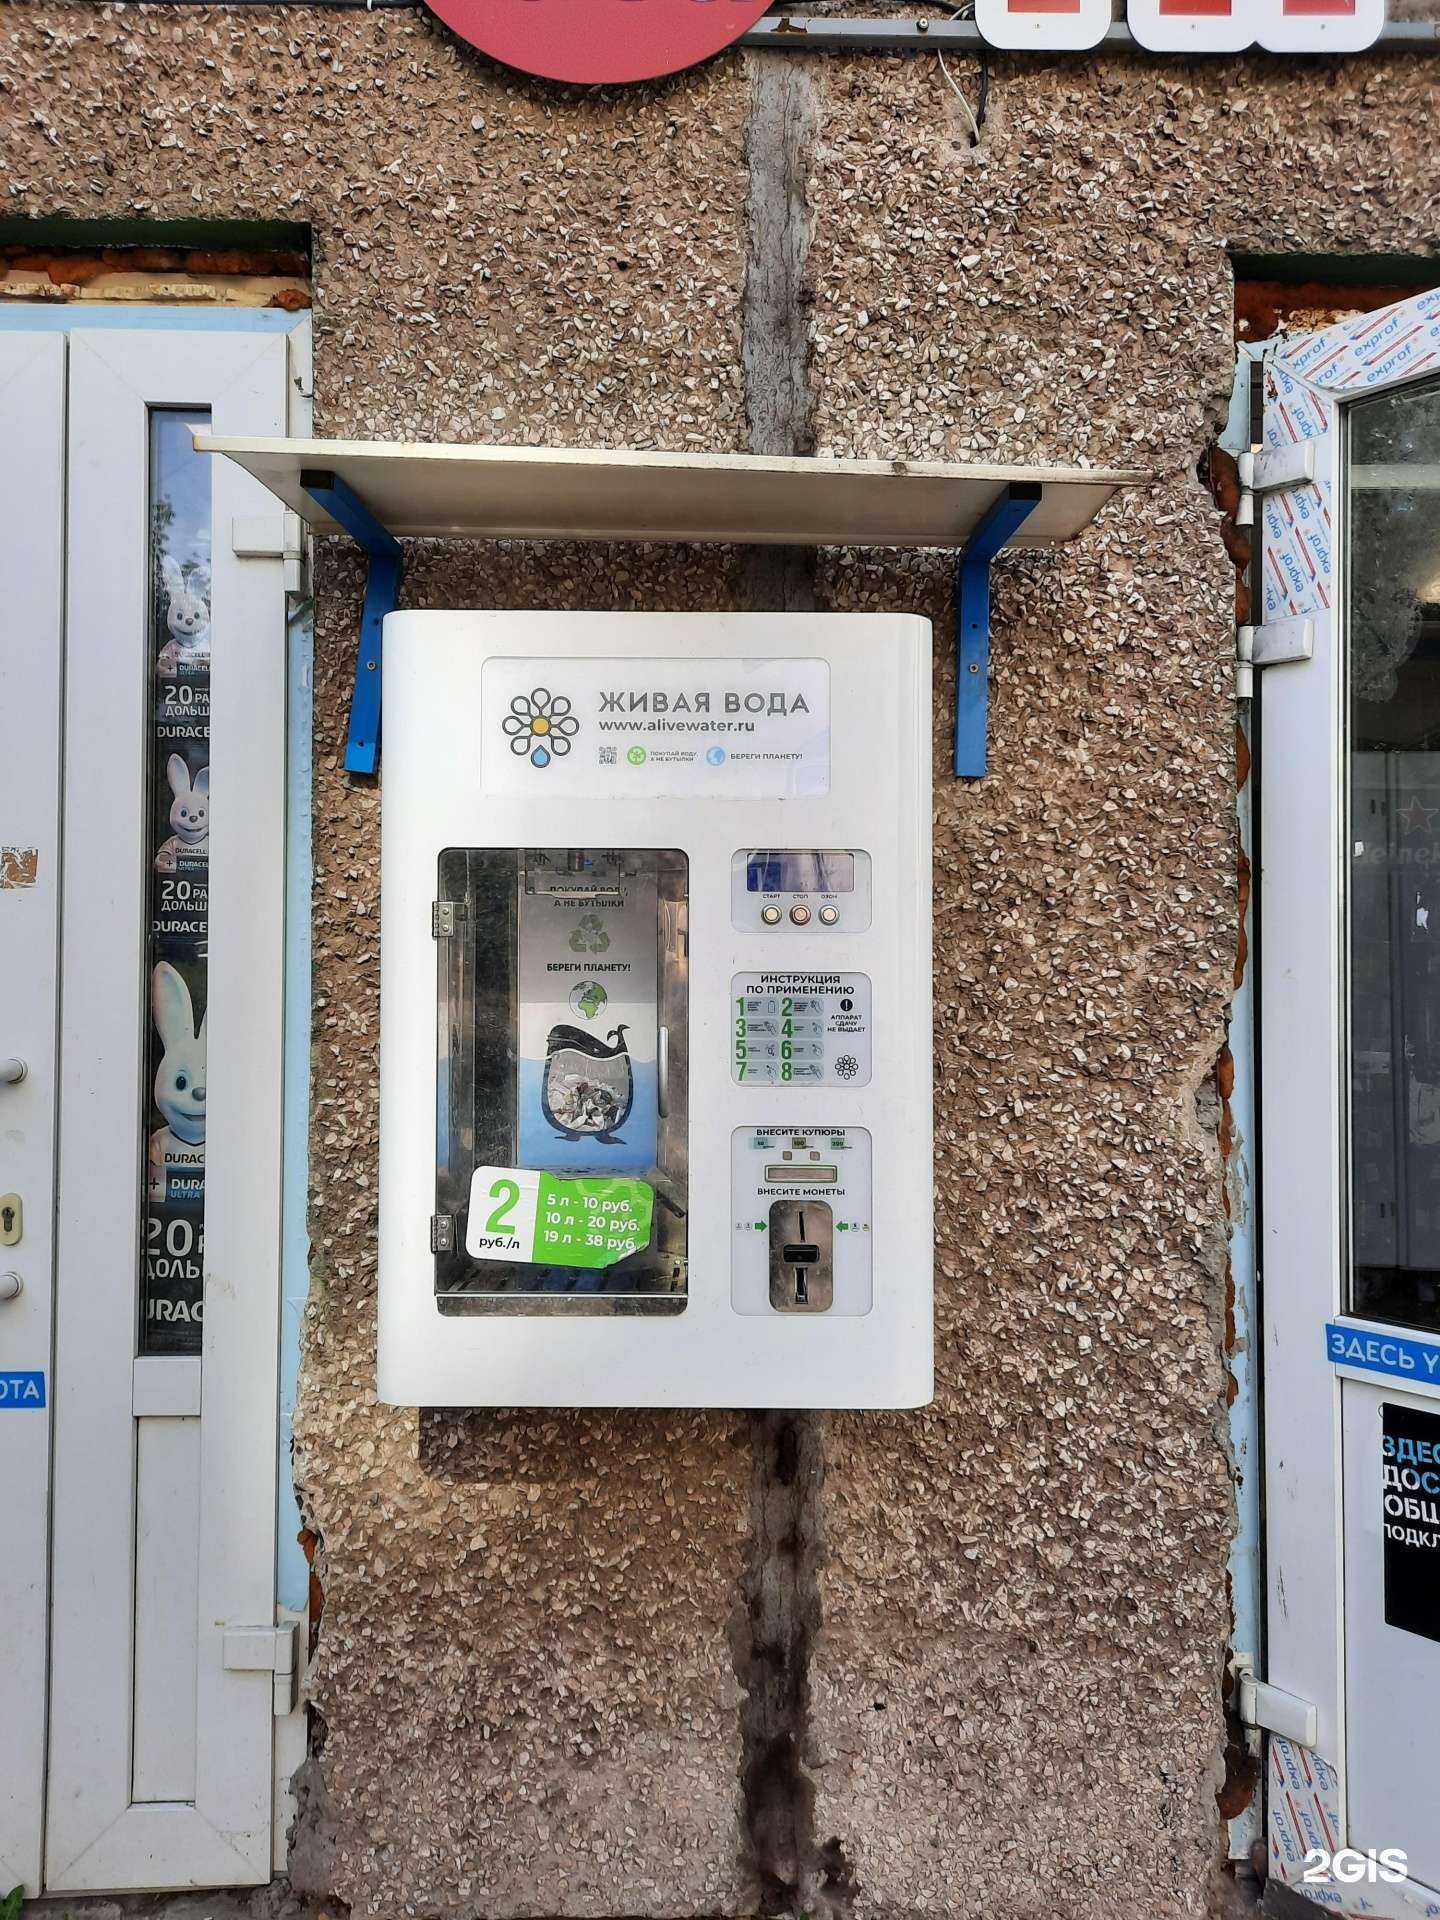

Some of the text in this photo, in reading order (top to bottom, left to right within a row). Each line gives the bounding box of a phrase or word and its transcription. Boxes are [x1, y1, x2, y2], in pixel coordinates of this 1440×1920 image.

[1354, 318, 1400, 357] exprof
[1367, 343, 1412, 383] exprof
[1278, 552, 1304, 593] exprof
[164, 685, 193, 705] 20
[598, 692, 811, 716] ЖИВАЯ ВОДА
[599, 717, 755, 733] www.alivewater.ru
[161, 880, 191, 900] 20
[547, 963, 631, 972] БЕРЕГИ ПЛАНЕТУ!
[746, 985, 855, 995] ПО ПРИМЕНЕНИЮ
[761, 975, 841, 985] ИНСТРУКЦИЯ
[736, 997, 745, 1016] 1
[781, 997, 793, 1017] 2
[736, 1018, 747, 1038] 3
[781, 1018, 793, 1038] 4
[736, 1040, 747, 1060] 5
[781, 1040, 792, 1060] 6
[736, 1061, 747, 1081] 7
[781, 1061, 792, 1081] 8
[802, 1129, 845, 1137] КУПЮРЫ
[164, 1153, 205, 1164] DURAC
[757, 1188, 845, 1196] ВНЕСИТЕ МОНЕТЫ
[485, 1179, 520, 1235] 2
[546, 1194, 556, 1206] 5
[559, 1196, 570, 1207] л
[583, 1196, 598, 1209] 10
[602, 1199, 633, 1213] руб.
[545, 1212, 561, 1224] 10
[564, 1216, 575, 1226] л
[588, 1216, 605, 1229] 20
[609, 1219, 641, 1233] руб.
[479, 1236, 520, 1250] руб./л
[544, 1229, 559, 1242] 19
[563, 1233, 572, 1243] л
[585, 1234, 603, 1247] 38
[1331, 1333, 1415, 1370] ЗДЕСЬ
